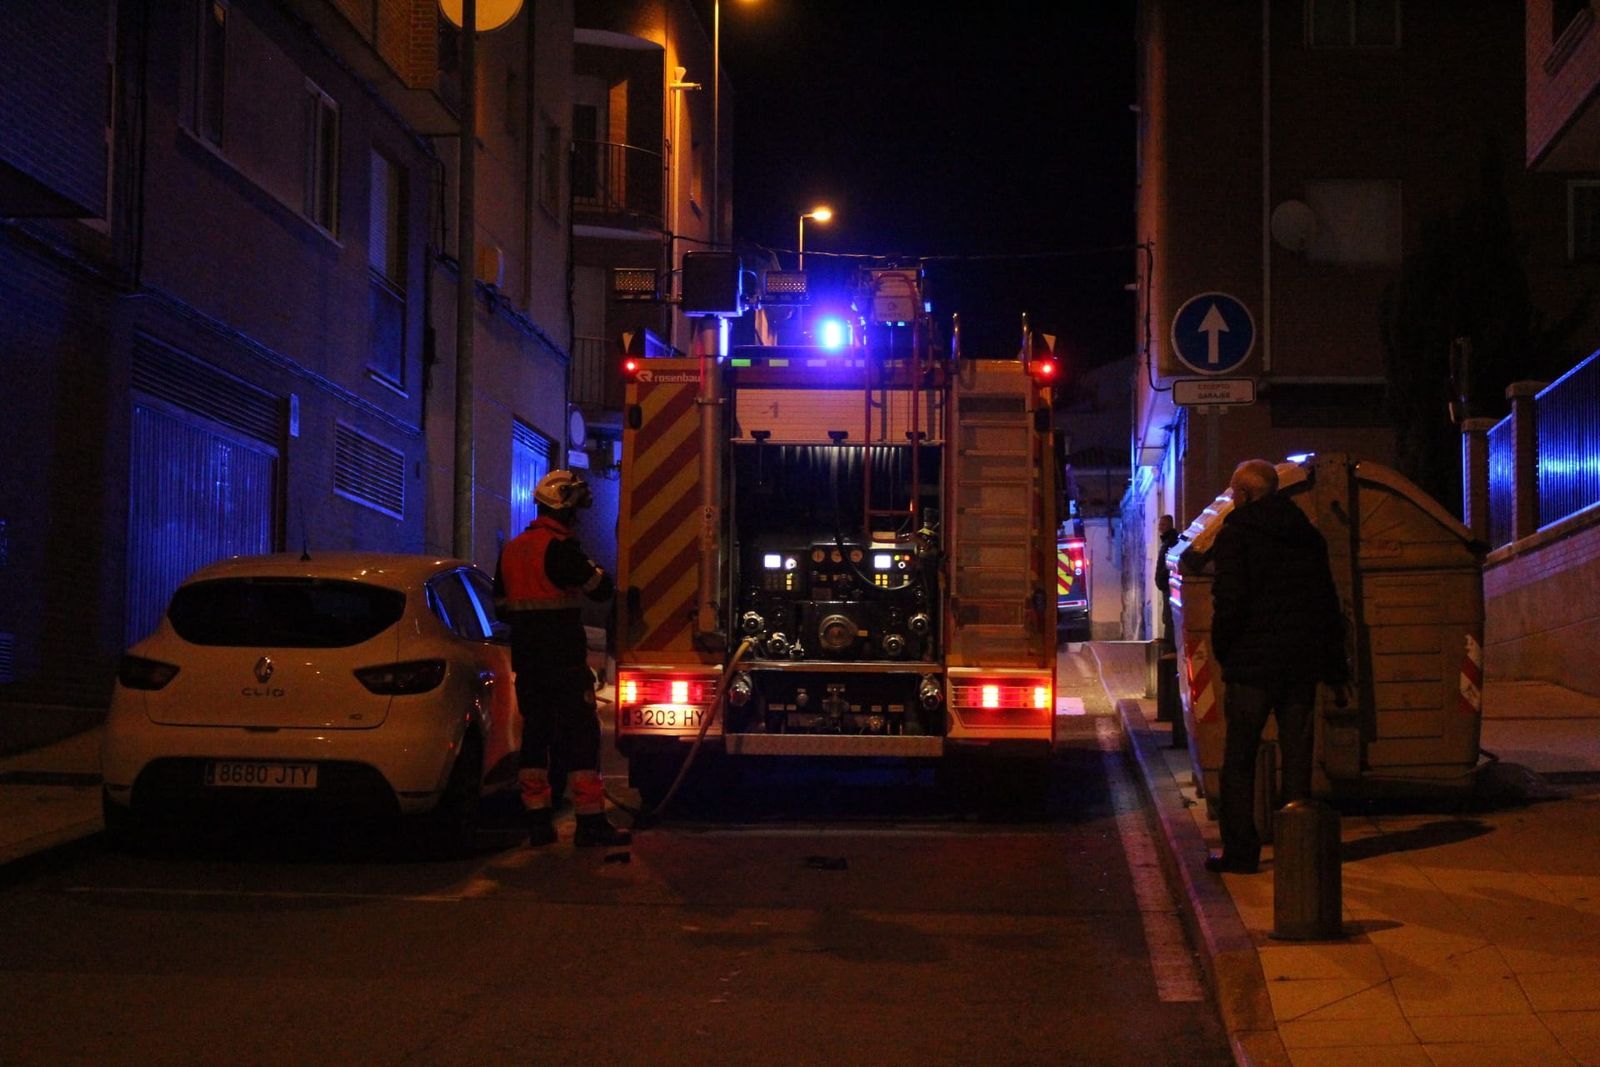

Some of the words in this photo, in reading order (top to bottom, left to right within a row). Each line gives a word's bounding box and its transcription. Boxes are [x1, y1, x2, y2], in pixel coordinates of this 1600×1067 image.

[654, 372, 701, 383] rosenbau
[241, 687, 285, 697] CLIO
[634, 709, 676, 726] 3203
[683, 710, 710, 726] HY
[219, 764, 268, 783] 8680
[274, 766, 312, 785] JTY
